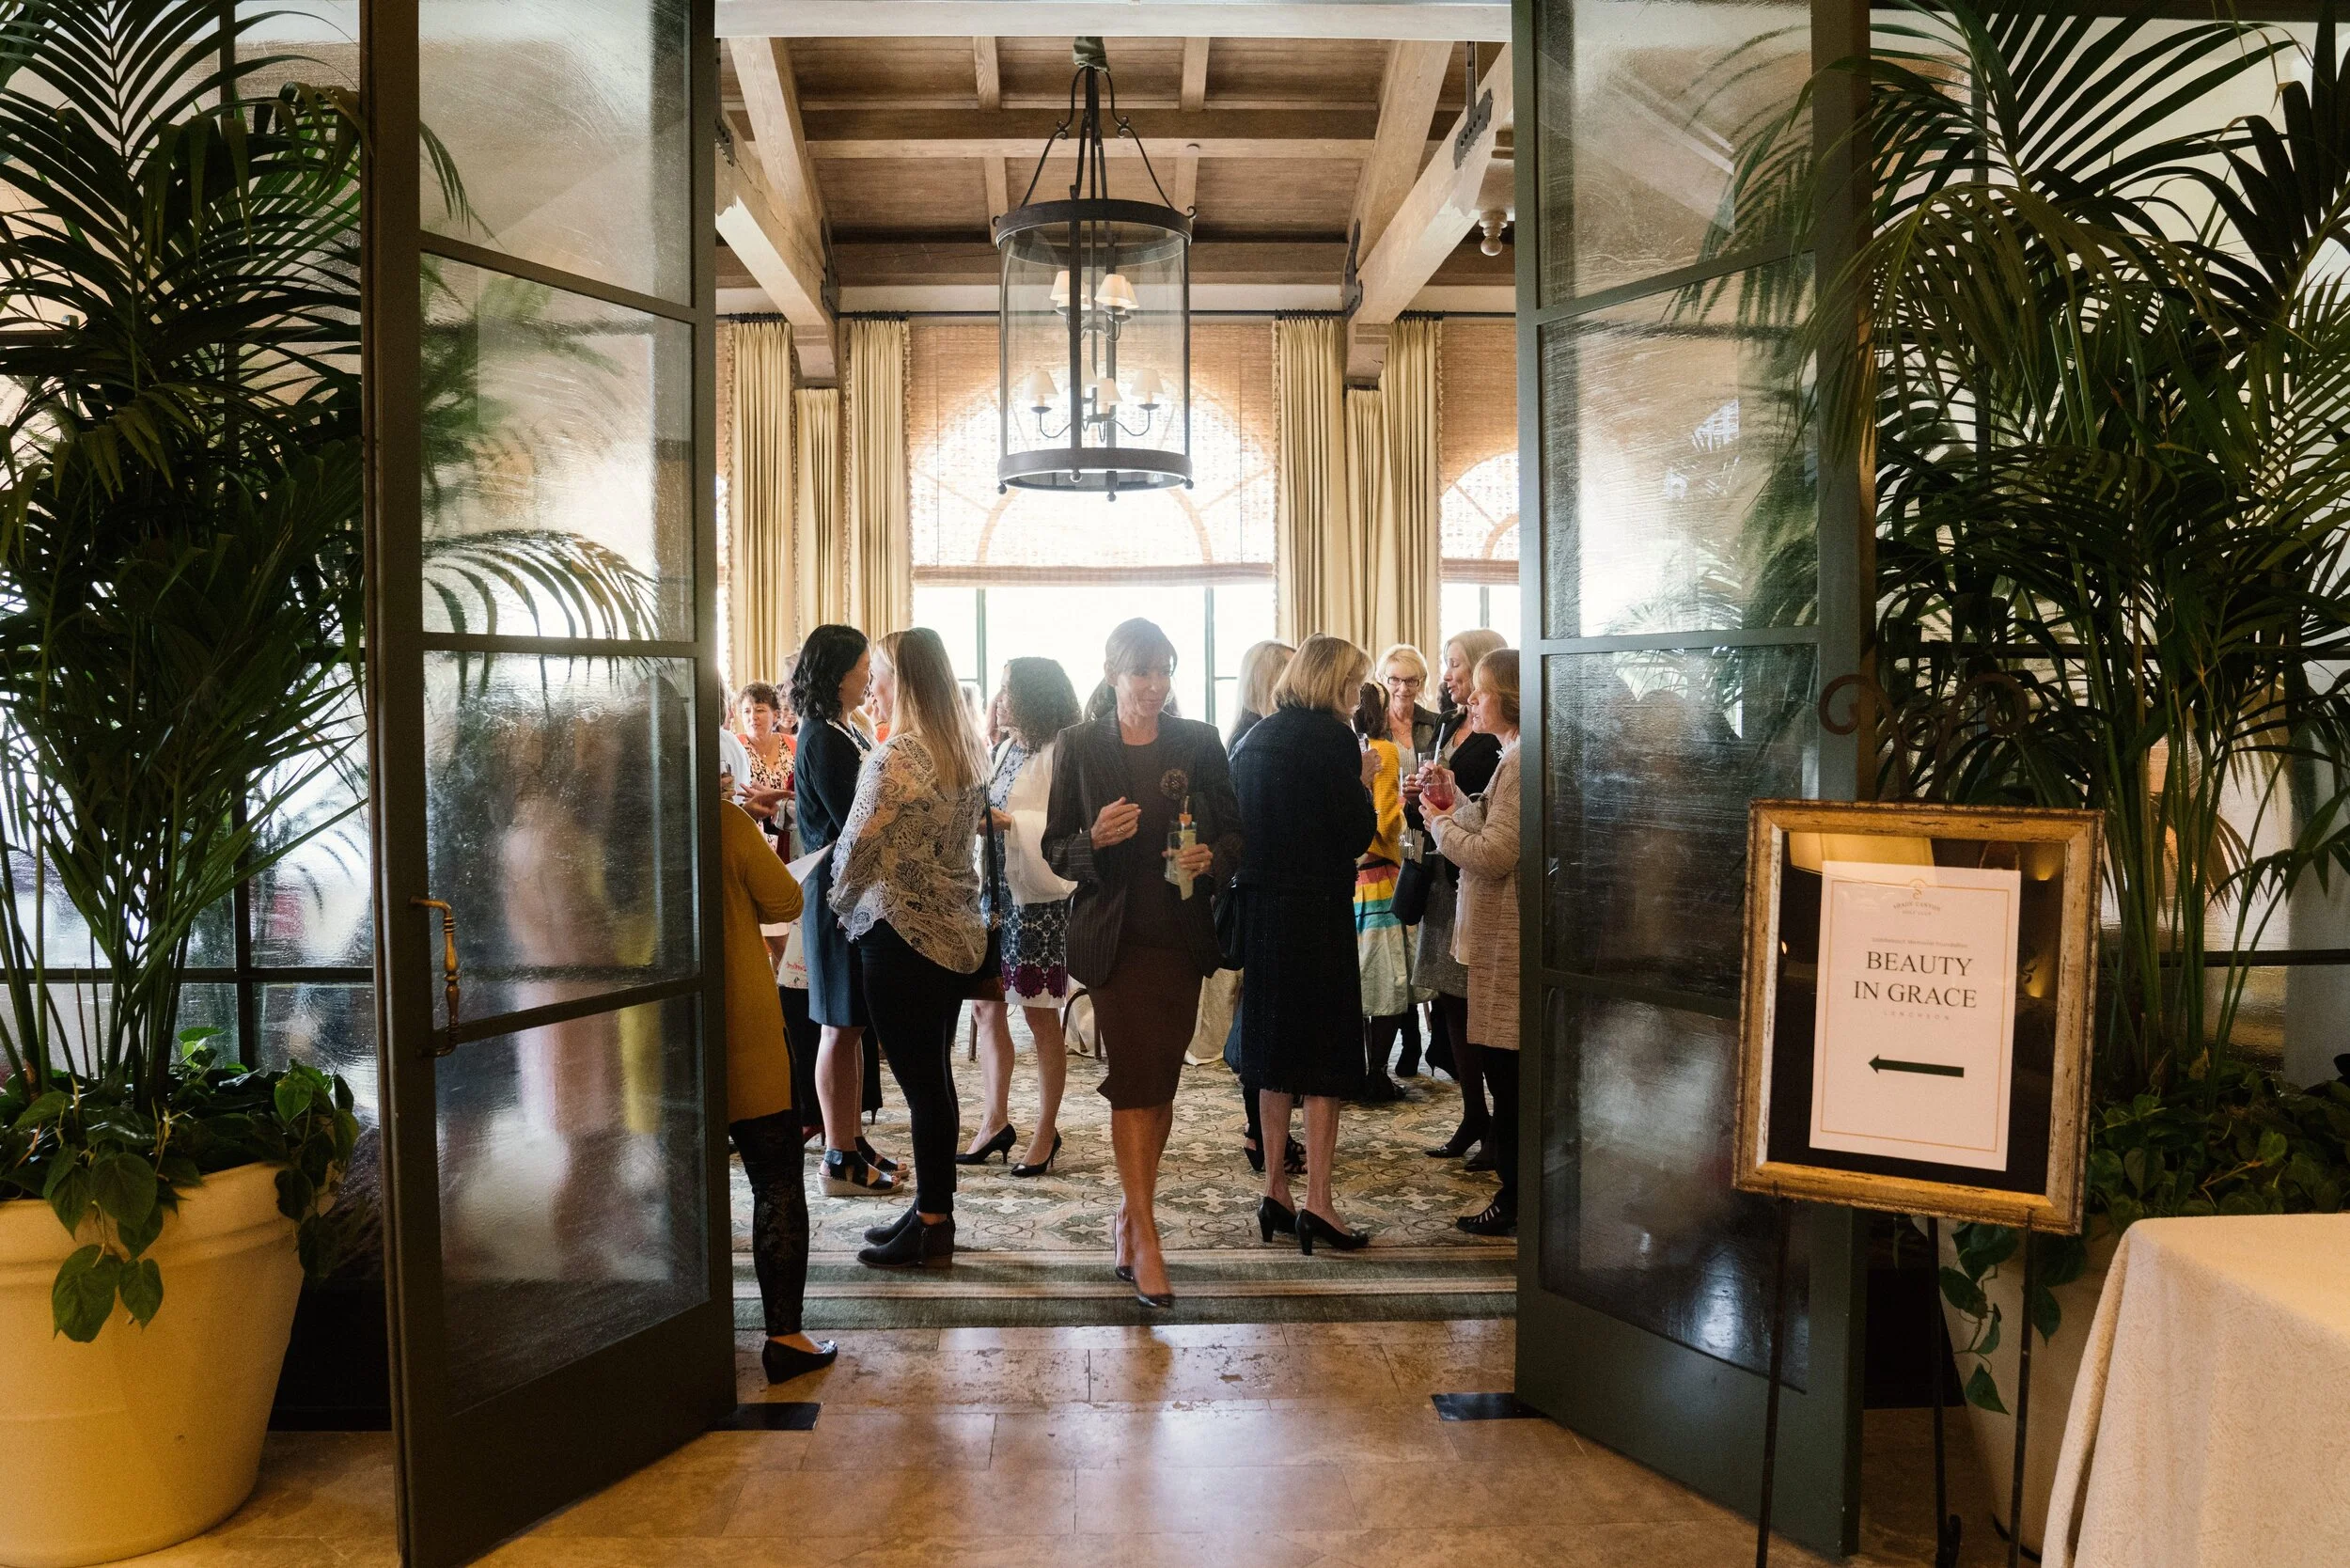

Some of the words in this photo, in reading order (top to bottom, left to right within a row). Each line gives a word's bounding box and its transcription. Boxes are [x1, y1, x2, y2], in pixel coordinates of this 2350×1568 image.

[1866, 951, 1973, 976] BEAUTY
[1854, 980, 1880, 999] IN
[1888, 983, 1977, 1009] GRACE
